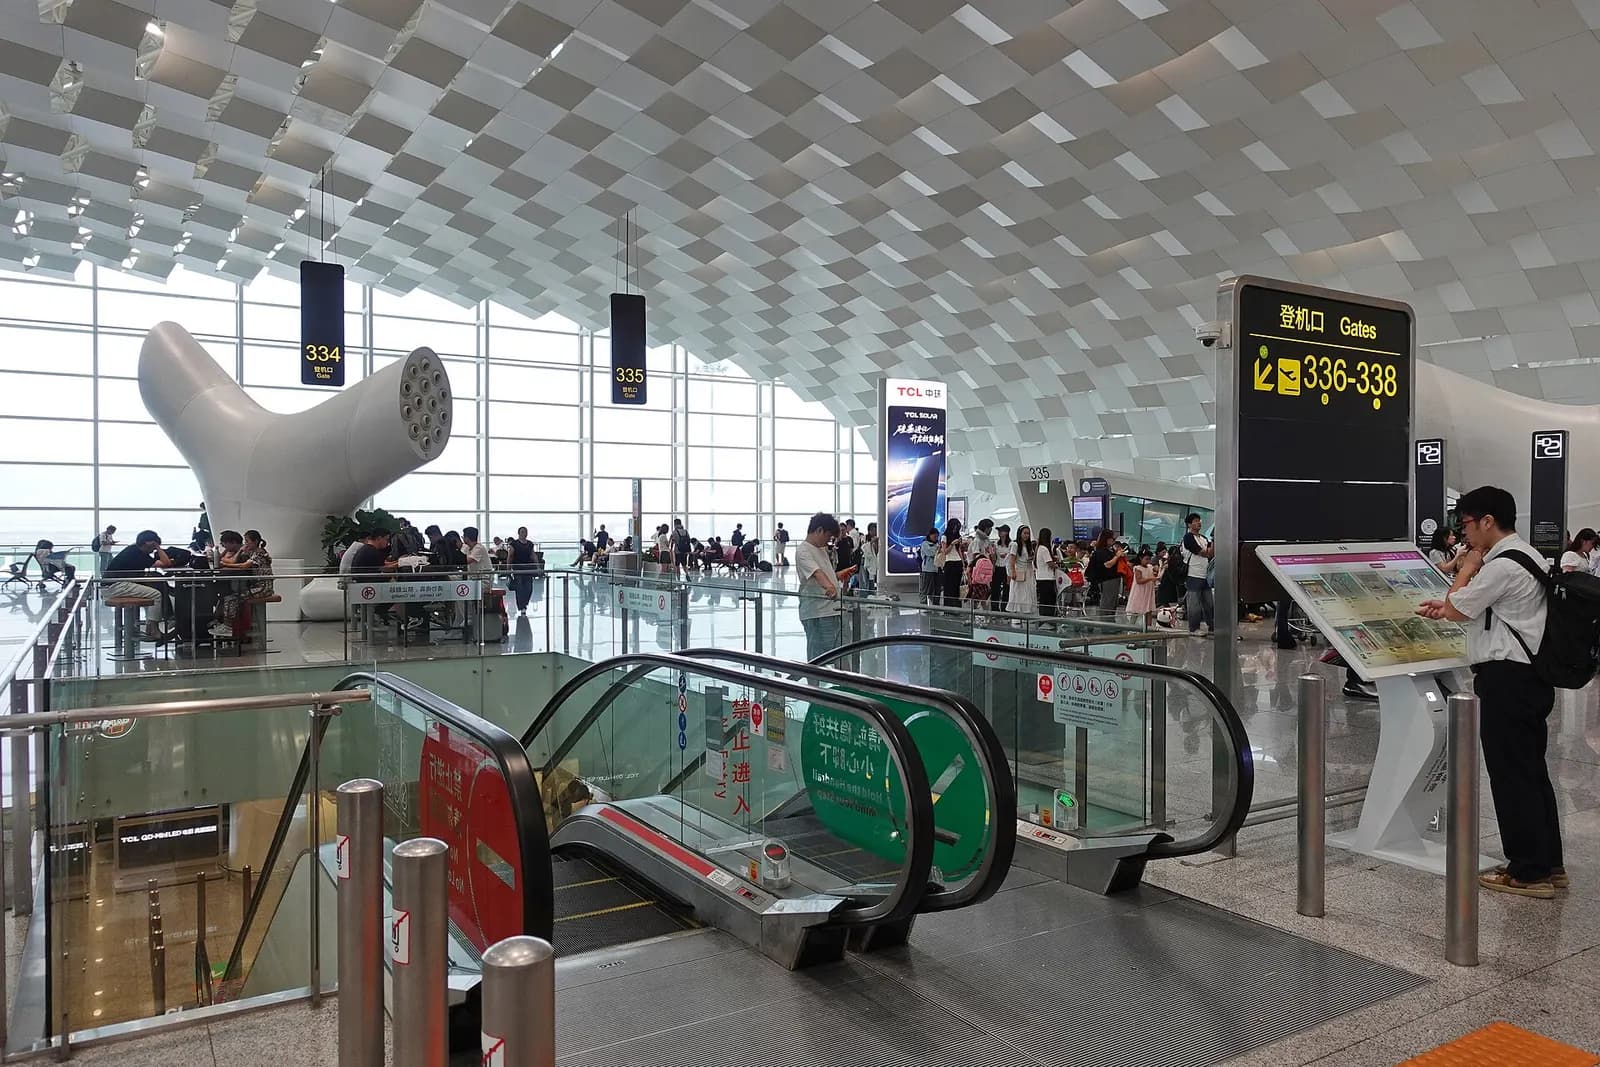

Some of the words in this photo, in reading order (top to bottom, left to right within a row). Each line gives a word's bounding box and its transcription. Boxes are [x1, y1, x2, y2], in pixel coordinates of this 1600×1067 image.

[1279, 304, 1325, 333] 登机口
[1340, 316, 1377, 340] Gates
[305, 344, 341, 363] 334
[616, 367, 644, 383] 335
[1303, 354, 1398, 397] 336-338
[897, 387, 923, 397] TCL
[1030, 466, 1050, 480] 335
[732, 698, 750, 815] 禁止进入
[121, 836, 140, 844] TCL
